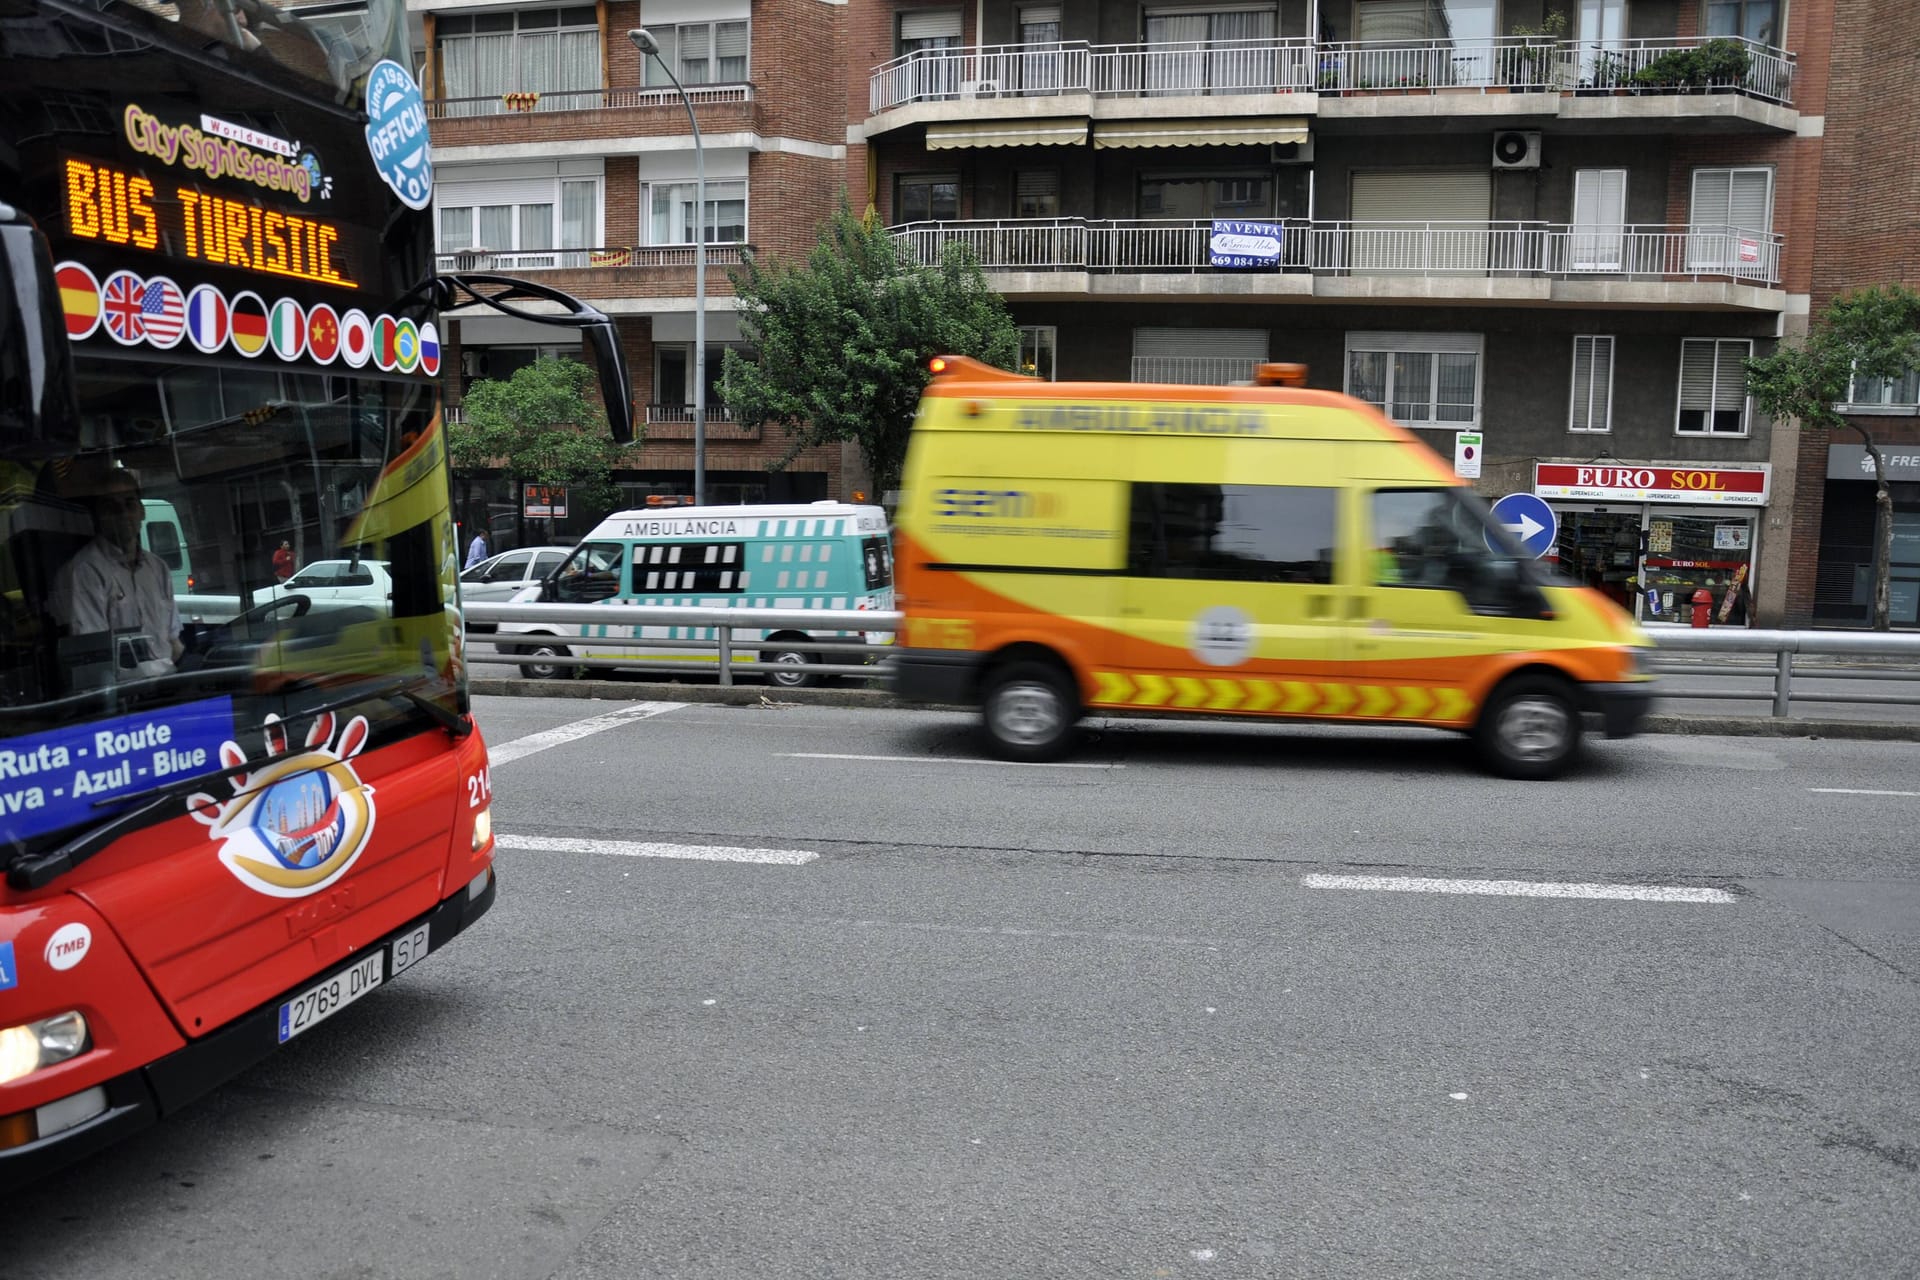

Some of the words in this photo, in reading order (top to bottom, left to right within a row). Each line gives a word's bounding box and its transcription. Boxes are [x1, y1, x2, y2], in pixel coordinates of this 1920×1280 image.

[210, 118, 289, 154] Worldwide
[66, 159, 157, 249] BUS
[177, 188, 340, 281] TURISTIC
[1214, 222, 1232, 233] EN
[1235, 223, 1279, 236] VENTA
[1211, 256, 1231, 266] 669
[1233, 257, 1253, 267] 084
[1257, 258, 1277, 267] 257
[1575, 467, 1656, 489] EURO
[1670, 470, 1726, 491] SOL
[0, 744, 70, 780] Ruta
[95, 722, 172, 758] Route
[72, 760, 131, 798] Azul
[152, 747, 207, 777] Blue
[55, 937, 85, 957] TMB
[293, 980, 340, 1030] 2769
[350, 958, 380, 996] DVL
